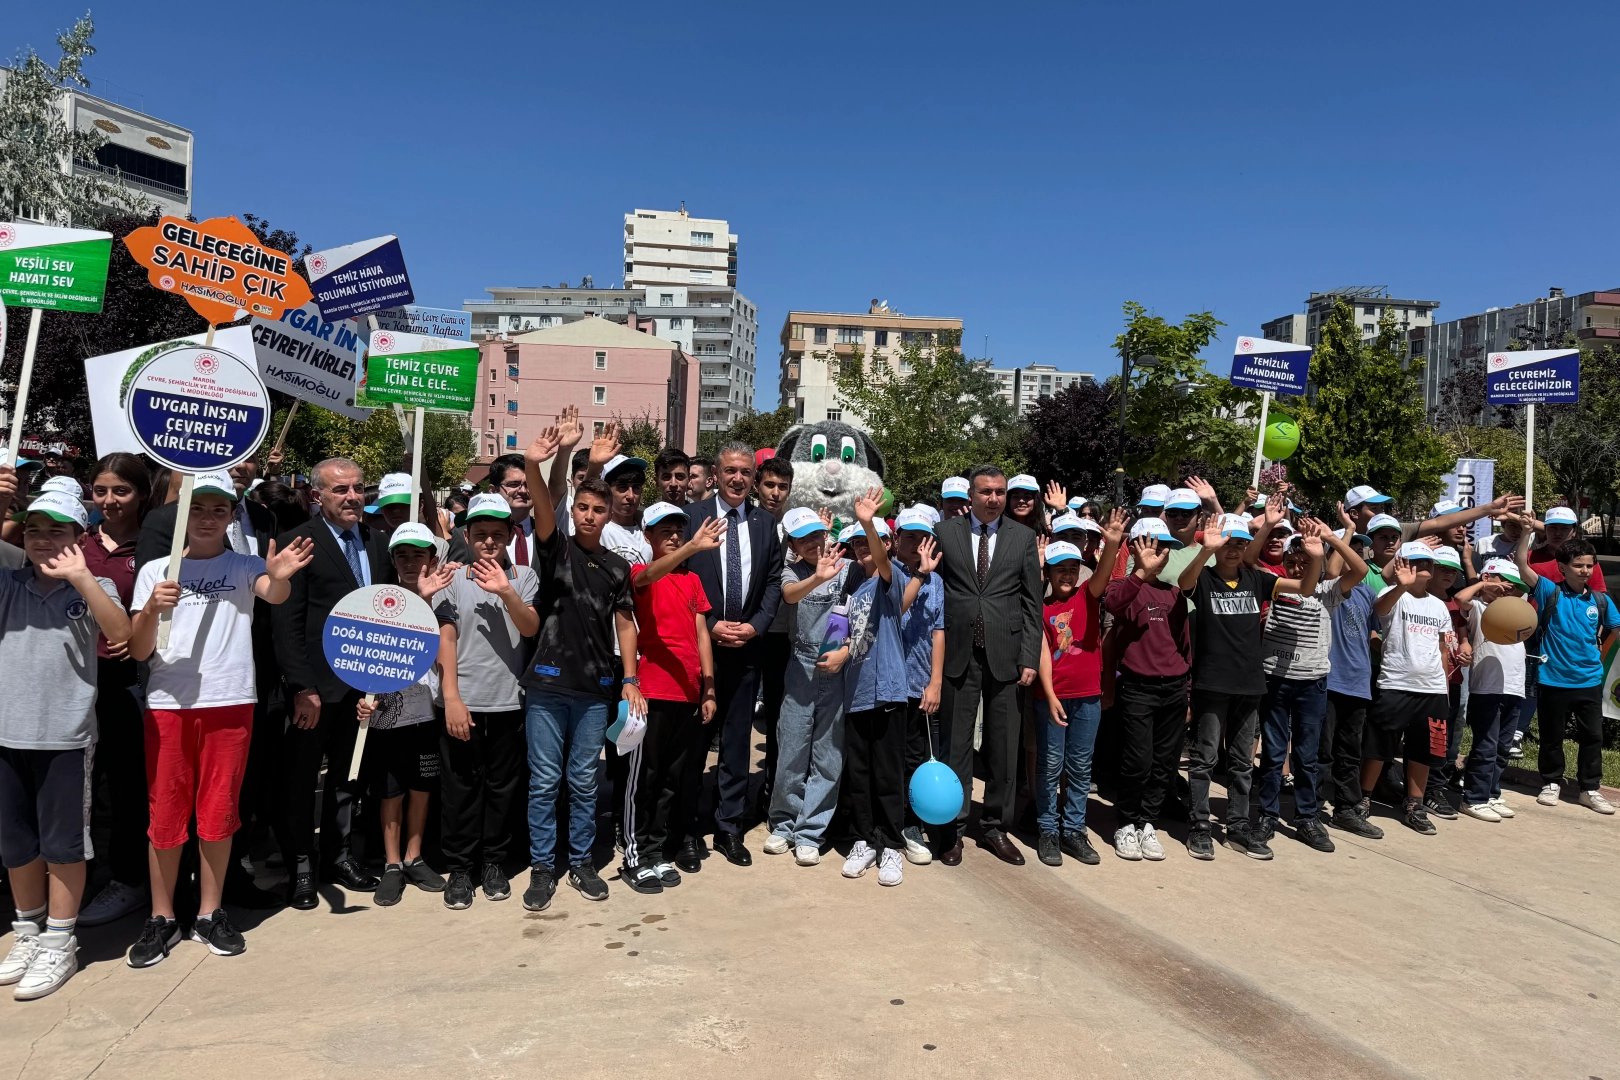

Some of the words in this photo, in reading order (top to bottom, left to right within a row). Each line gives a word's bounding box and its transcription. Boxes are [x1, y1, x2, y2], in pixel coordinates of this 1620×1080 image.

[162, 222, 288, 276] GELECEĞİNE
[15, 256, 50, 271] YEŞİLİ
[52, 260, 74, 272] SEV
[152, 245, 236, 283] SAHİP
[243, 273, 287, 301] ÇIK
[9, 272, 50, 286] HAYATI
[52, 276, 74, 288] SEV
[332, 270, 359, 284] TEMİZ
[359, 265, 384, 279] HAVA
[318, 284, 358, 302] SOLUMAK
[358, 273, 406, 293] İSTİYORUM
[280, 308, 335, 342] YGAR
[393, 320, 429, 334] Koruma
[432, 324, 464, 338] Haftası
[422, 312, 438, 323] Çevre
[440, 314, 456, 324] Günü
[458, 317, 466, 326] ve
[310, 348, 357, 383] KİRLET
[386, 358, 420, 372] TEMİZ
[424, 362, 460, 377] ÇEVRE
[1243, 364, 1295, 382] İMANDANDIR
[1253, 356, 1290, 370] TEMİZLİK
[192, 376, 216, 384] MARDİN
[385, 370, 408, 386] İÇİN
[412, 376, 424, 388] EL
[428, 378, 457, 392] ELE...
[1508, 368, 1557, 381] ÇEVREMİZ
[147, 375, 167, 384] ÇEVRE,
[168, 378, 199, 388] ŞEHİRCİLİK
[208, 383, 224, 392] İKLİM
[224, 386, 258, 398] DEĞİŞİKLİĞİ
[188, 388, 224, 399] MÜDÜRLÜĞÜ
[1493, 378, 1572, 392] GELECEĞİMİZDİR
[150, 396, 200, 416] UYGAR
[202, 402, 248, 423] İNSAN
[166, 418, 228, 438] ÇEVREYİ
[152, 431, 234, 457] KİRLETMEZ
[178, 574, 236, 600] erfect
[332, 626, 364, 641] DOĞA
[366, 632, 398, 647] SENİN
[340, 644, 363, 657] ONU
[364, 647, 416, 666] KORUMAK
[1272, 648, 1300, 662] LEGEND
[333, 658, 366, 673] SENİN
[367, 662, 416, 682] GÖREVİN
[1428, 716, 1446, 758] NIKE
